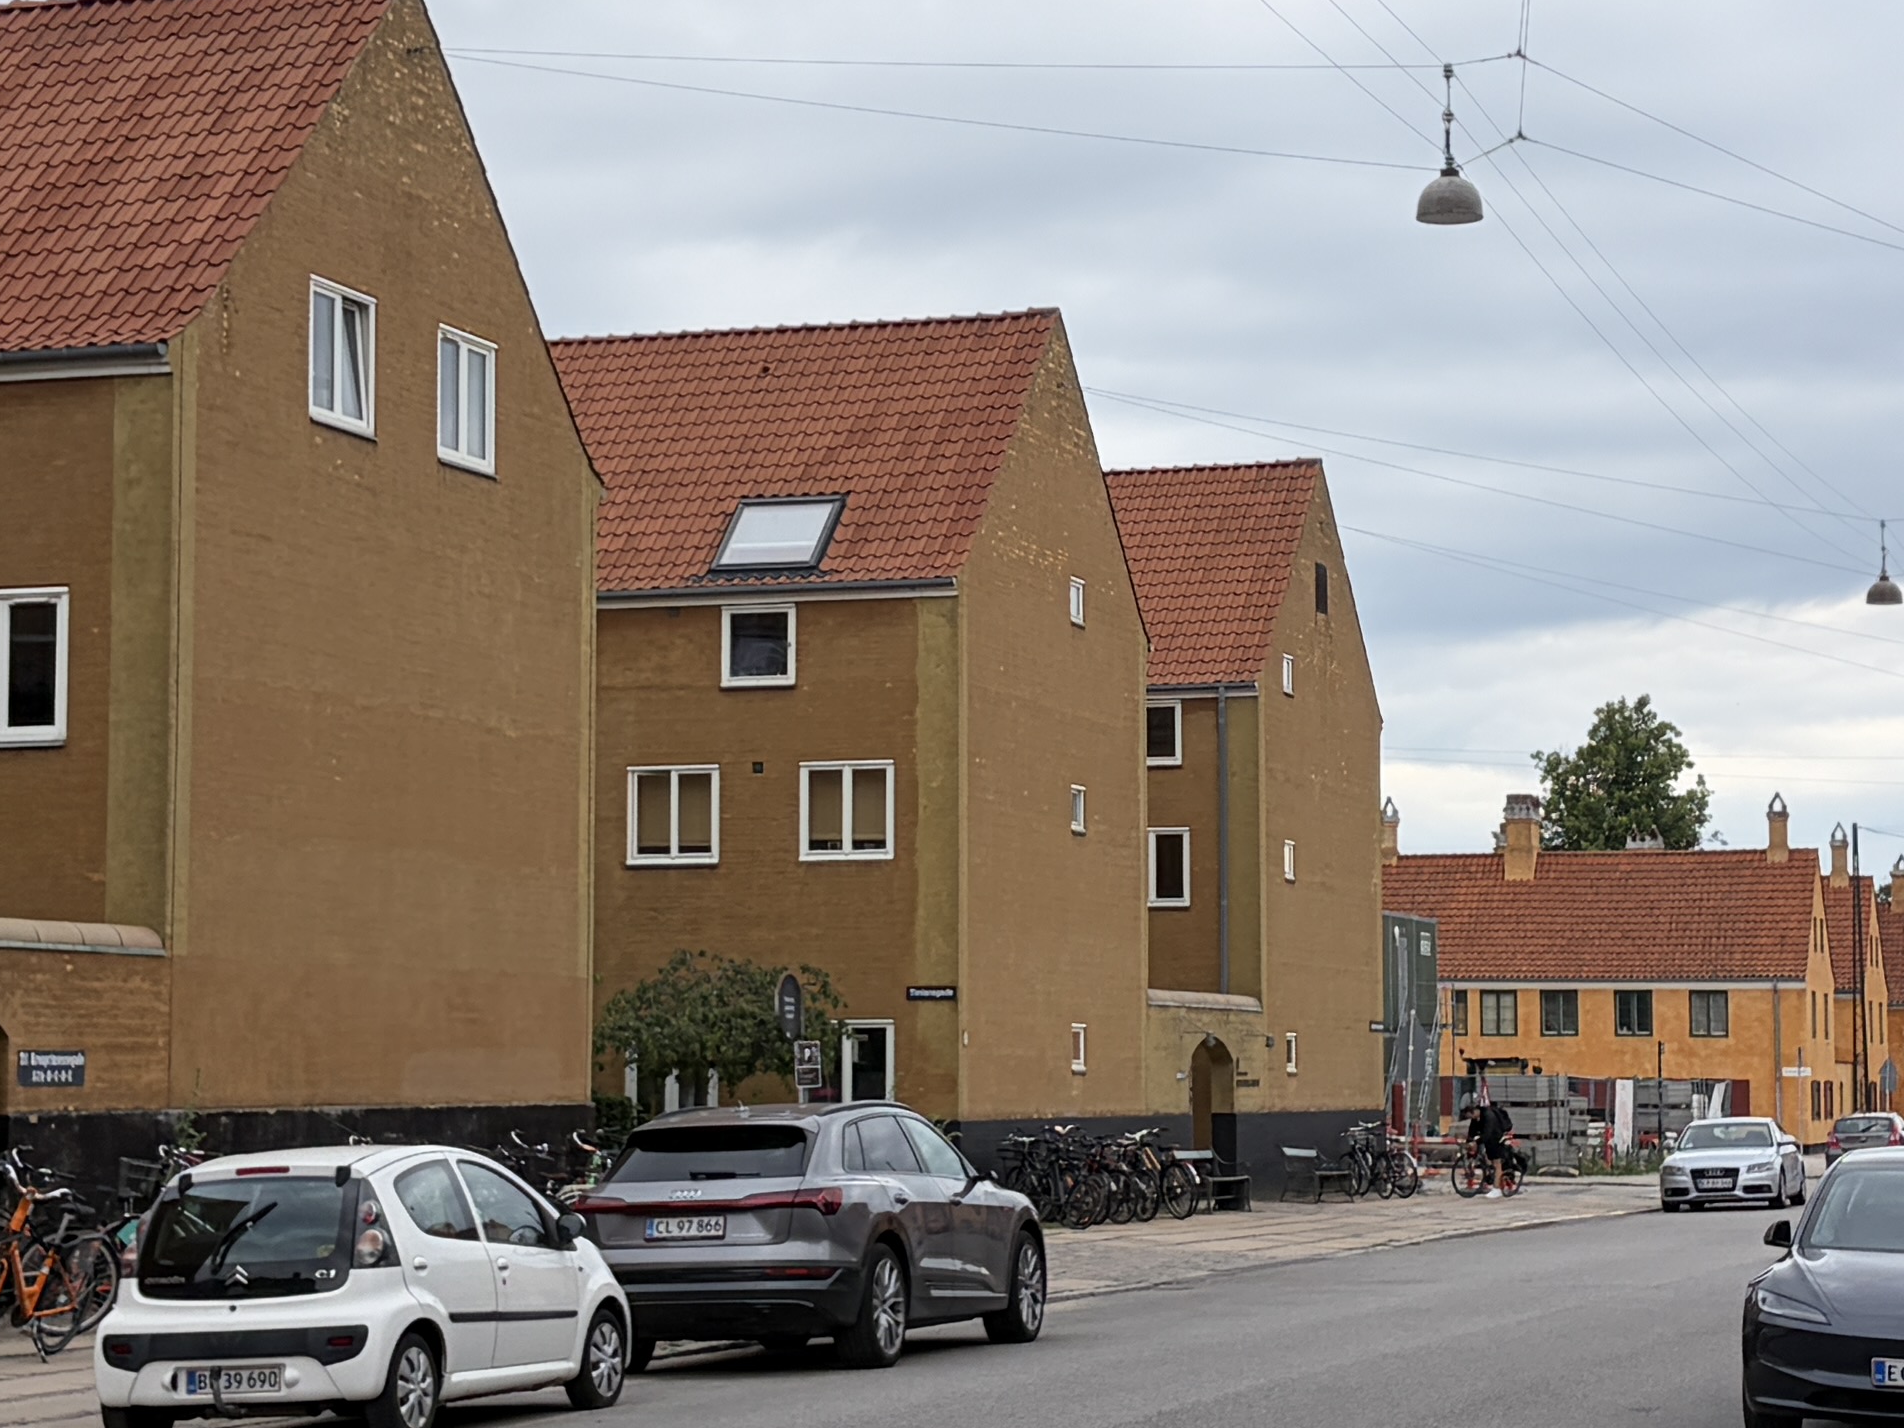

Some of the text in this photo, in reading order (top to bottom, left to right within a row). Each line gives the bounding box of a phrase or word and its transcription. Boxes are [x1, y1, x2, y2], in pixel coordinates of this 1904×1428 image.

[656, 1218, 722, 1234] CL 97 866
[223, 1372, 243, 1390] 39
[247, 1371, 277, 1388] 690
